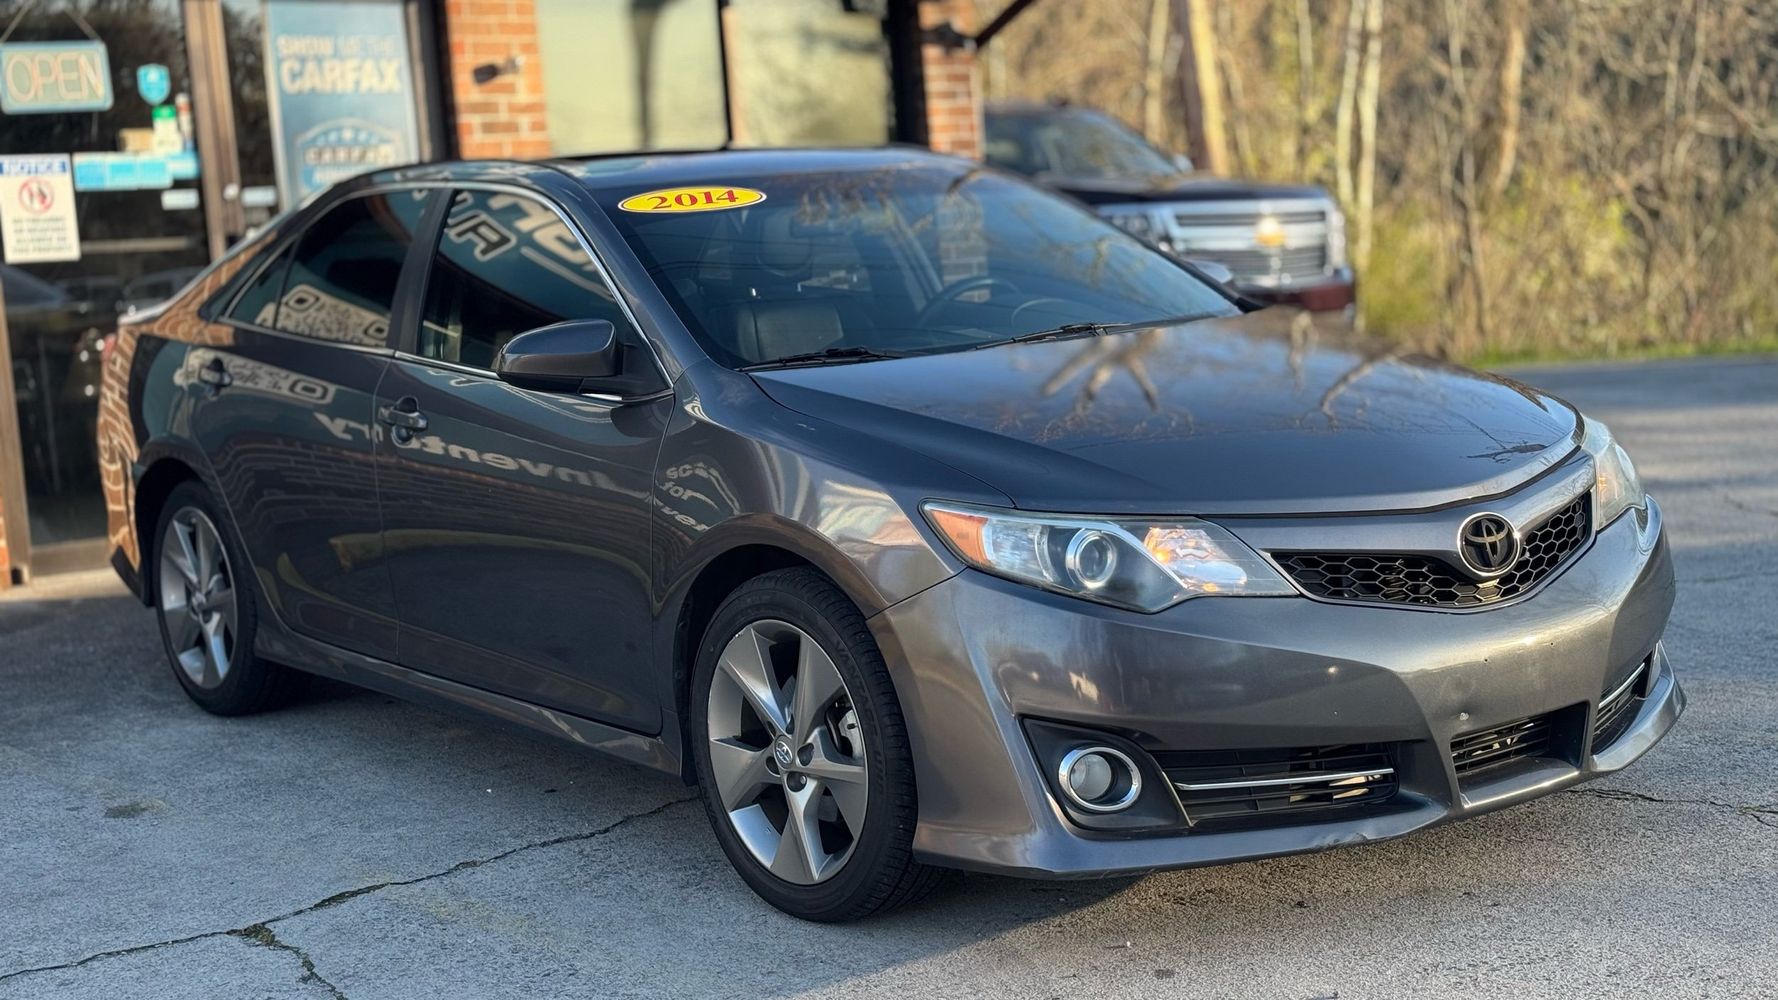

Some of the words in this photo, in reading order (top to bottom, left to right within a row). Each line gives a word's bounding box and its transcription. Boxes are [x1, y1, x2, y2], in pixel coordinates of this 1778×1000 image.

[6, 52, 105, 102] OPEN
[280, 58, 401, 94] CARFAX
[647, 189, 740, 210] 2014
